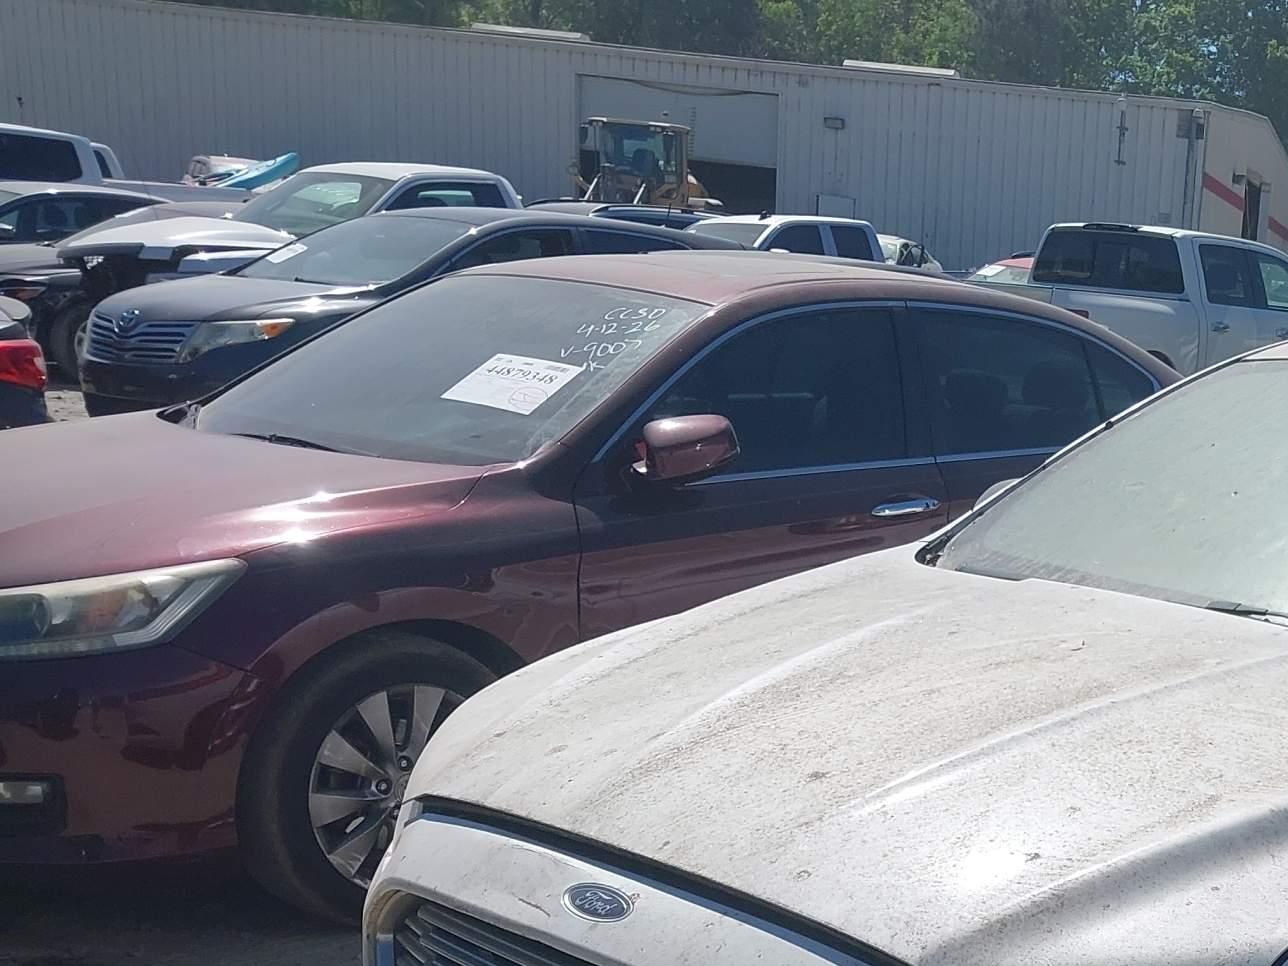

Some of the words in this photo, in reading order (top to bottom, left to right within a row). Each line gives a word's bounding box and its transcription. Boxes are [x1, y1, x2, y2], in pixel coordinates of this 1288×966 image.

[576, 320, 661, 337] 4-12-26
[487, 364, 558, 384] 44879348
[575, 890, 618, 915] Ford
